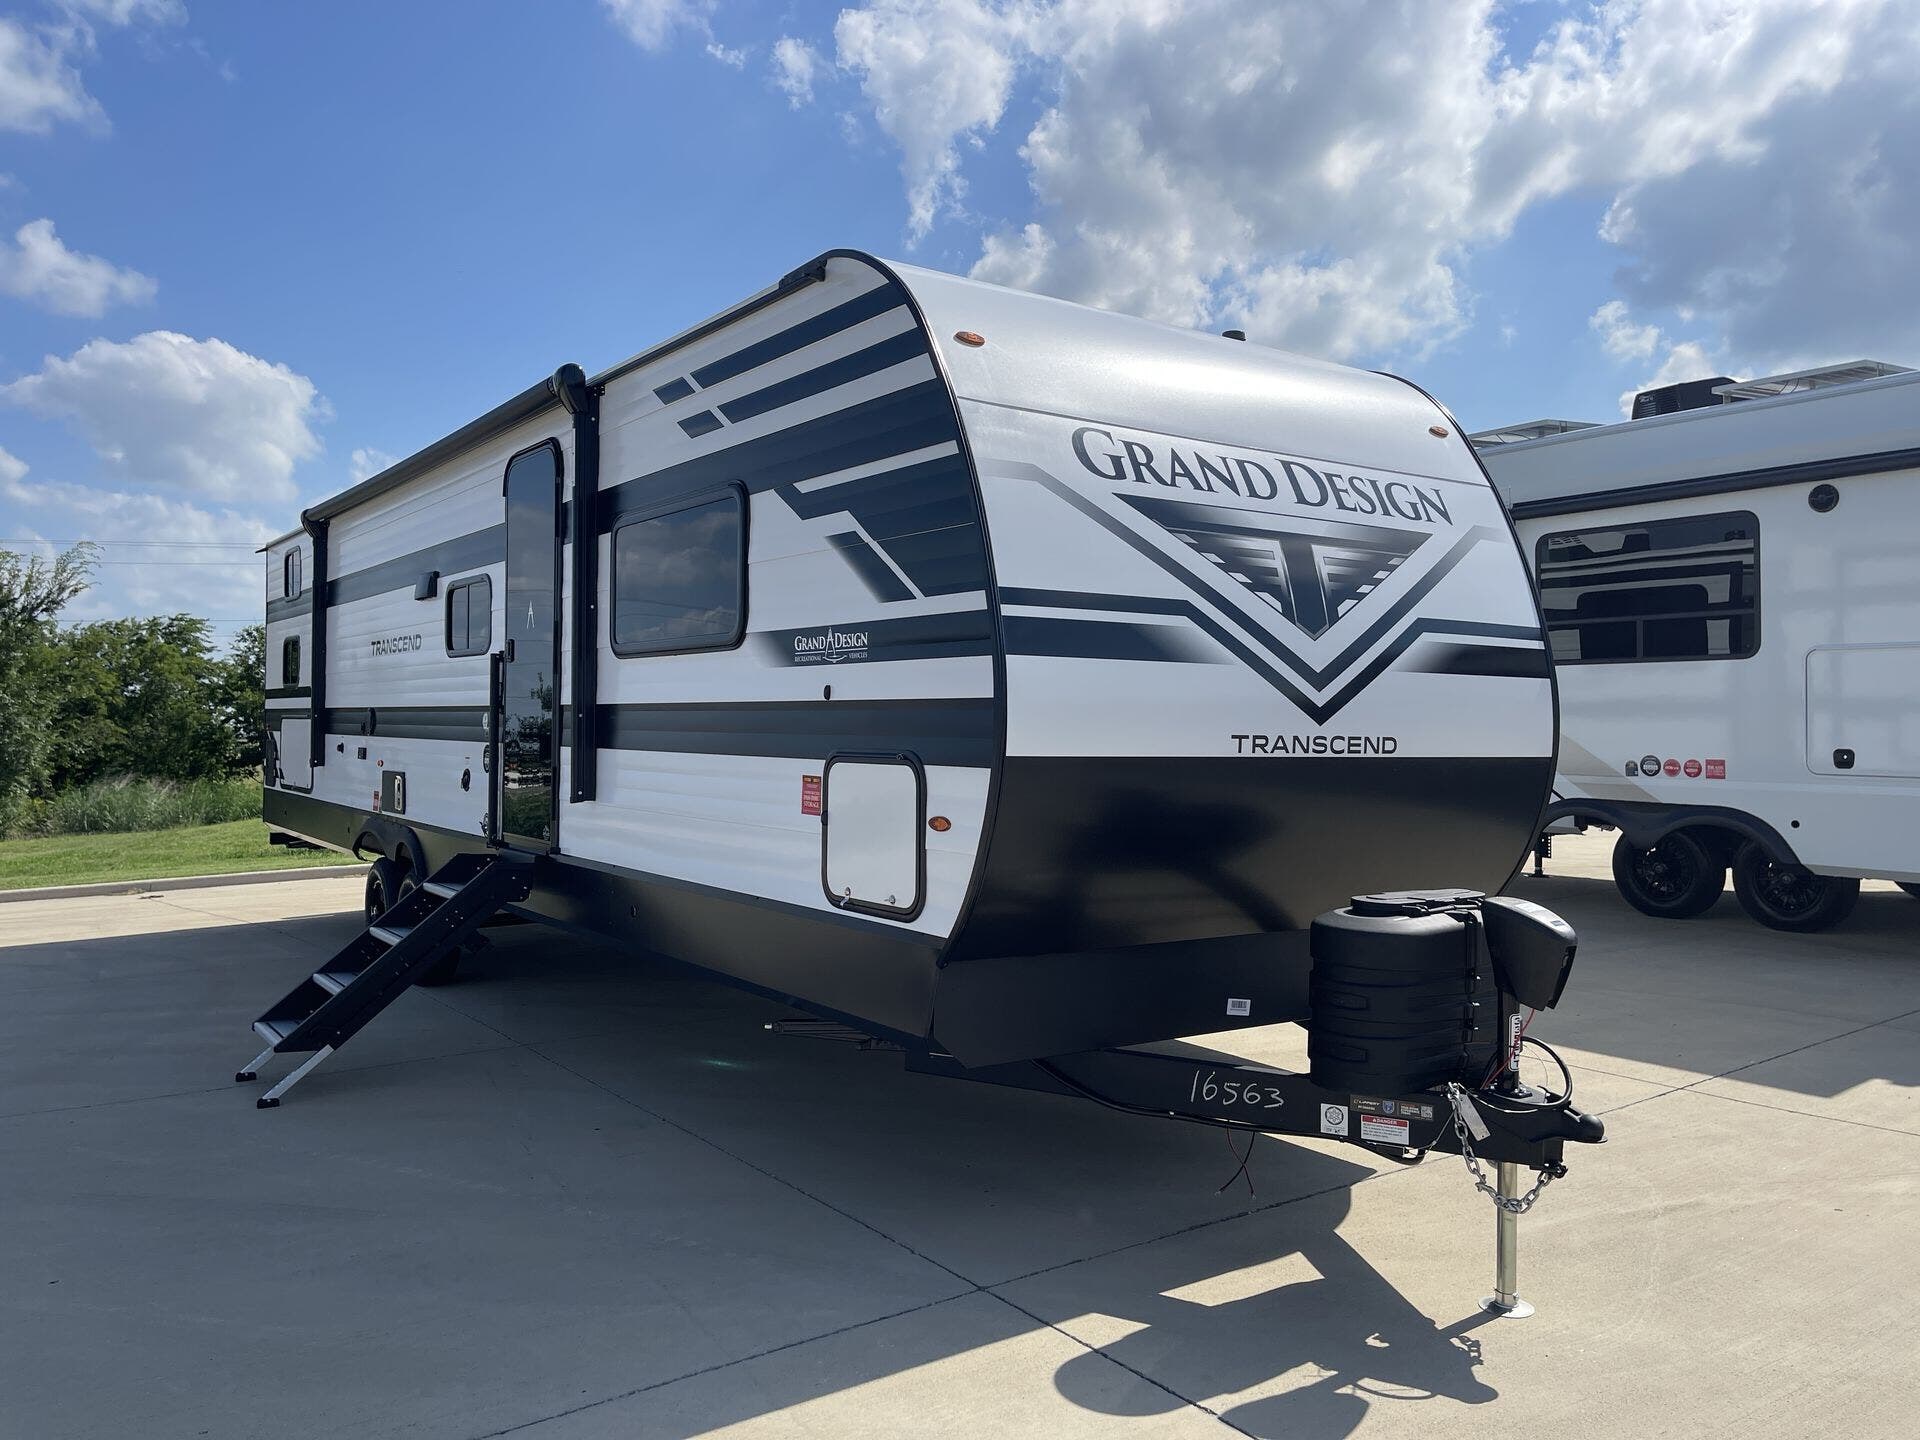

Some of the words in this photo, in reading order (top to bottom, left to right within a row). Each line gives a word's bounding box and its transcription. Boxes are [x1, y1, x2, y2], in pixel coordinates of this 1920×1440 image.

[1071, 426, 1278, 501] GRAND
[1274, 458, 1454, 527] DESIGN
[370, 634, 422, 656] TRANSCEND
[794, 635, 826, 651] GRAND
[834, 632, 868, 648] DESIGN
[1231, 734, 1398, 755] TRANSCEND
[1190, 1069, 1285, 1109] 16563
